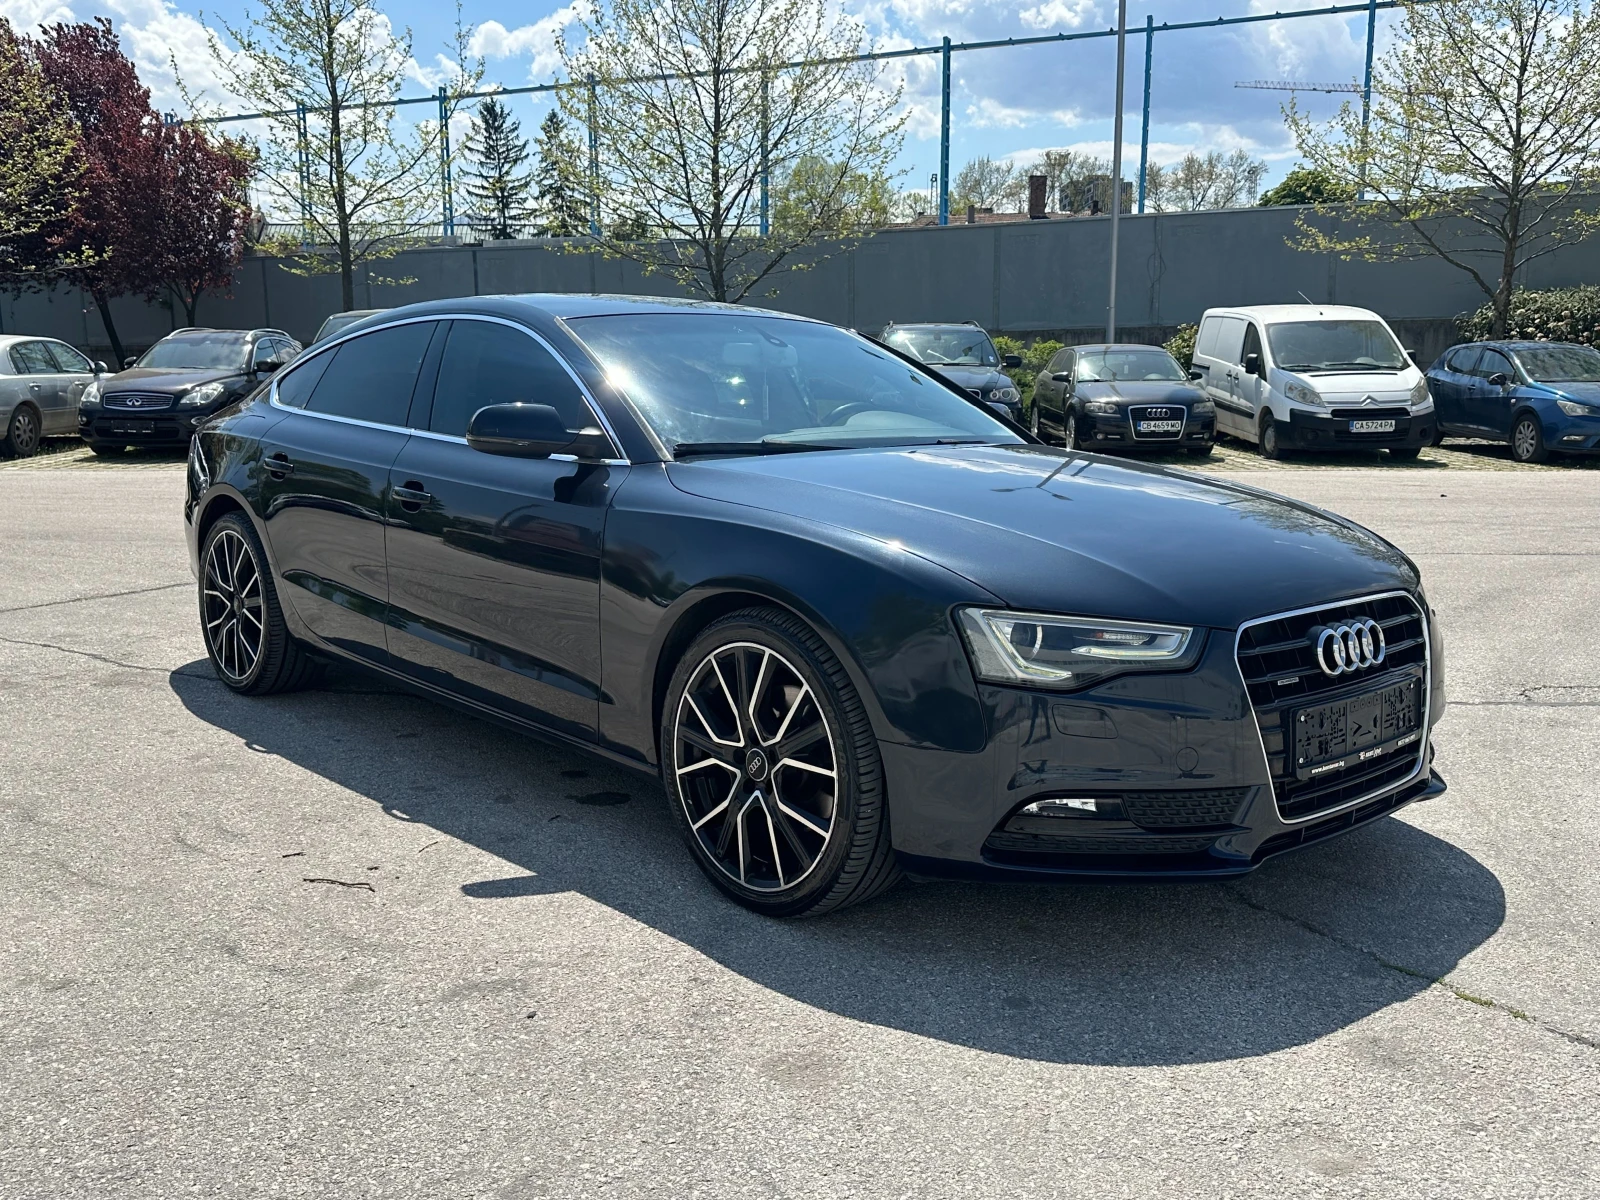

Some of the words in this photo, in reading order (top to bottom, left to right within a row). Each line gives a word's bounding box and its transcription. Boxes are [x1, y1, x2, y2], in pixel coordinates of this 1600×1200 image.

[1153, 421, 1169, 429] 4659
[1365, 421, 1383, 429] 5724
[1384, 421, 1394, 429] PA
